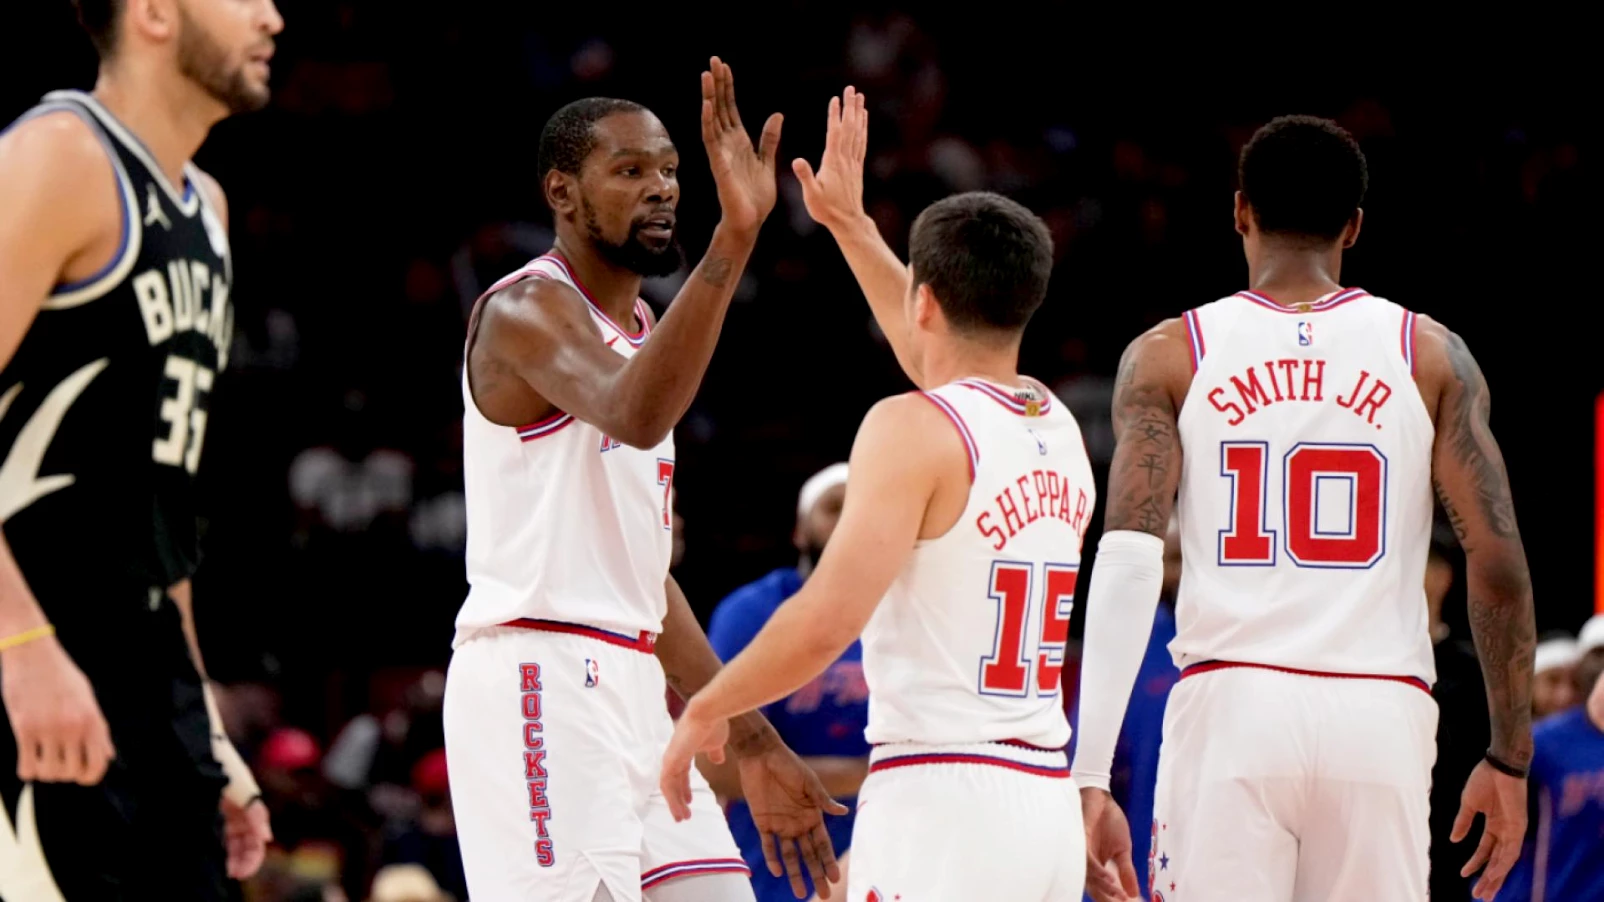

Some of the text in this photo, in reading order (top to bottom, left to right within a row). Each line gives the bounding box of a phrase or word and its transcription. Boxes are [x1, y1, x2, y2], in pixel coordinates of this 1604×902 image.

[1207, 359, 1392, 430] SMITH JR.
[976, 469, 1093, 553] SHEPPAR
[1217, 440, 1388, 570] 10
[978, 559, 1081, 698] 15
[518, 662, 555, 867] ROCKETS
